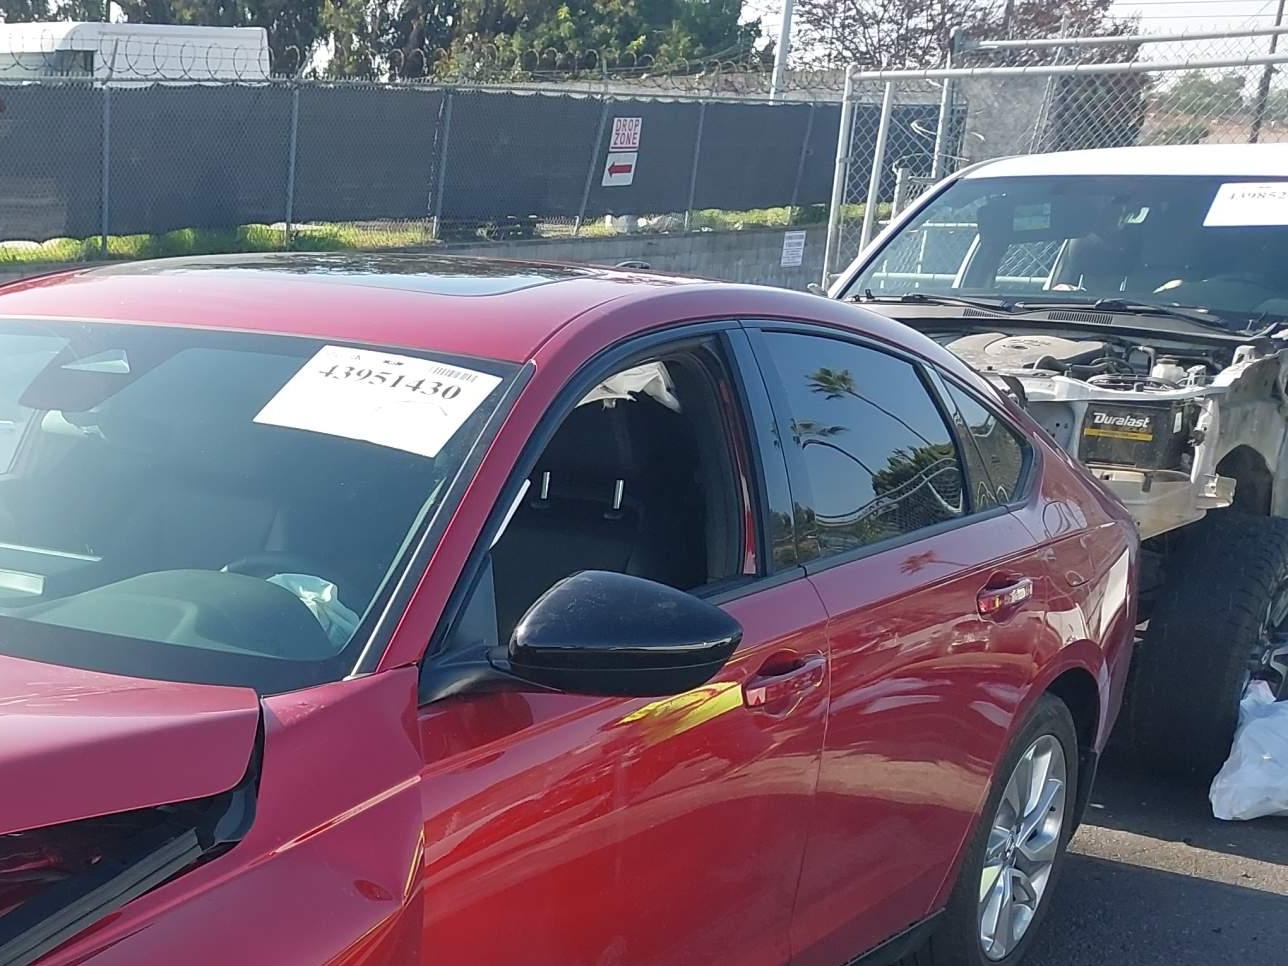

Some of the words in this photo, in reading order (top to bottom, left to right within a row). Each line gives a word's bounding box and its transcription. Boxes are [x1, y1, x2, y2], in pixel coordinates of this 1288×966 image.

[615, 118, 640, 132] DROP
[613, 132, 638, 146] ZONE
[318, 363, 463, 400] 43951430
[1093, 412, 1150, 428] Duralast
